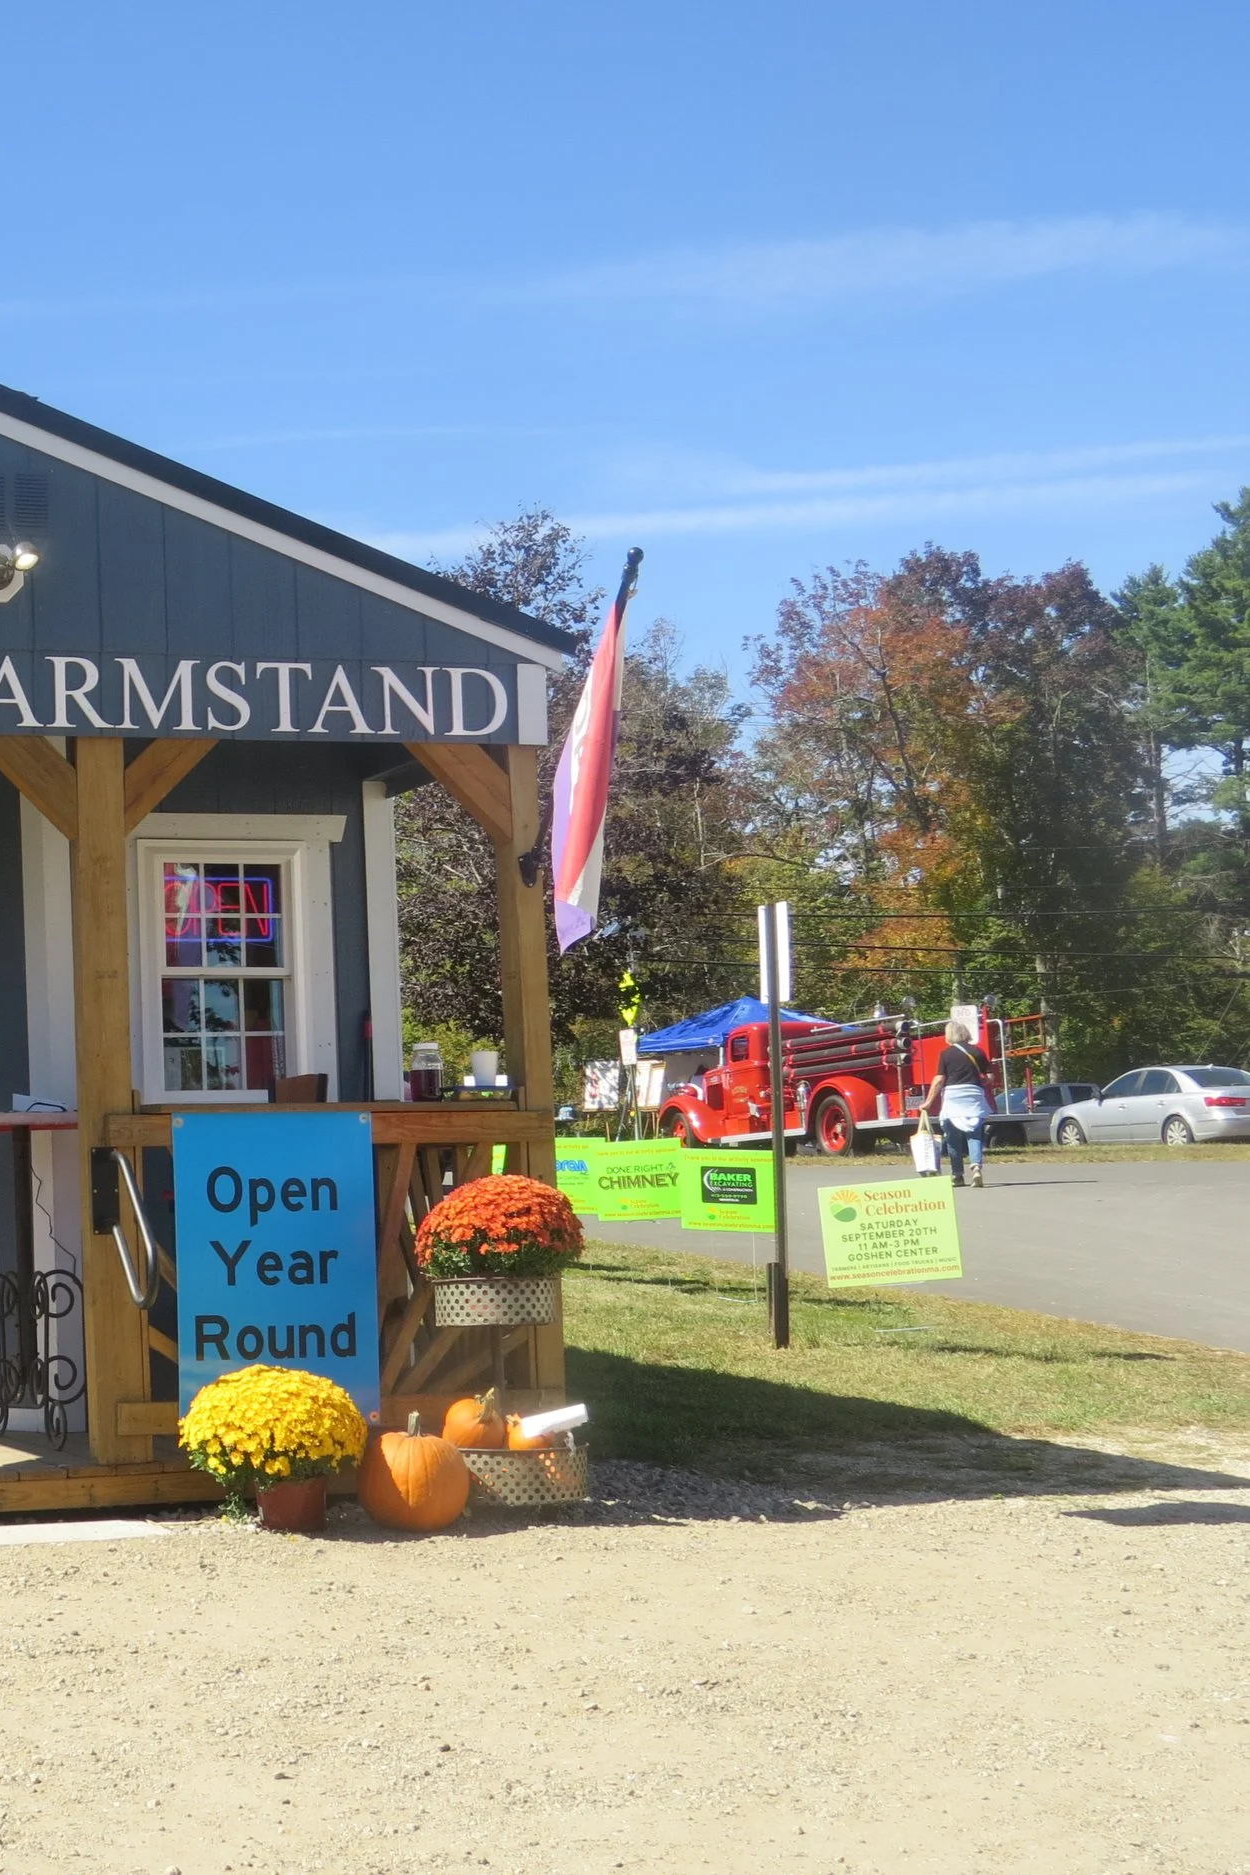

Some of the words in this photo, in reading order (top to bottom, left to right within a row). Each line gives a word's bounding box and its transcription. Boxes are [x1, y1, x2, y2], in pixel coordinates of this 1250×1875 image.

[164, 882, 269, 937] OPEN
[606, 1166, 631, 1174] DONE
[634, 1164, 664, 1173] RIGHT
[710, 1172, 752, 1182] BAKER
[598, 1172, 679, 1191] CHIMNEY
[206, 1166, 338, 1227] Open
[863, 1188, 911, 1202] Season
[865, 1199, 946, 1216] Celebration
[860, 1218, 918, 1231] SATURDAY
[842, 1230, 905, 1242] SEPTEMBER
[908, 1226, 938, 1237] 20TH
[858, 1243, 868, 1251] 11
[872, 1240, 900, 1250] AM-3
[904, 1238, 920, 1247] PM
[848, 1251, 892, 1262] GOSHEN
[896, 1246, 938, 1258] CENTER
[209, 1240, 339, 1286] Year
[830, 1264, 960, 1281] www.seasoncelebrationma.com
[194, 1311, 357, 1361] Round
